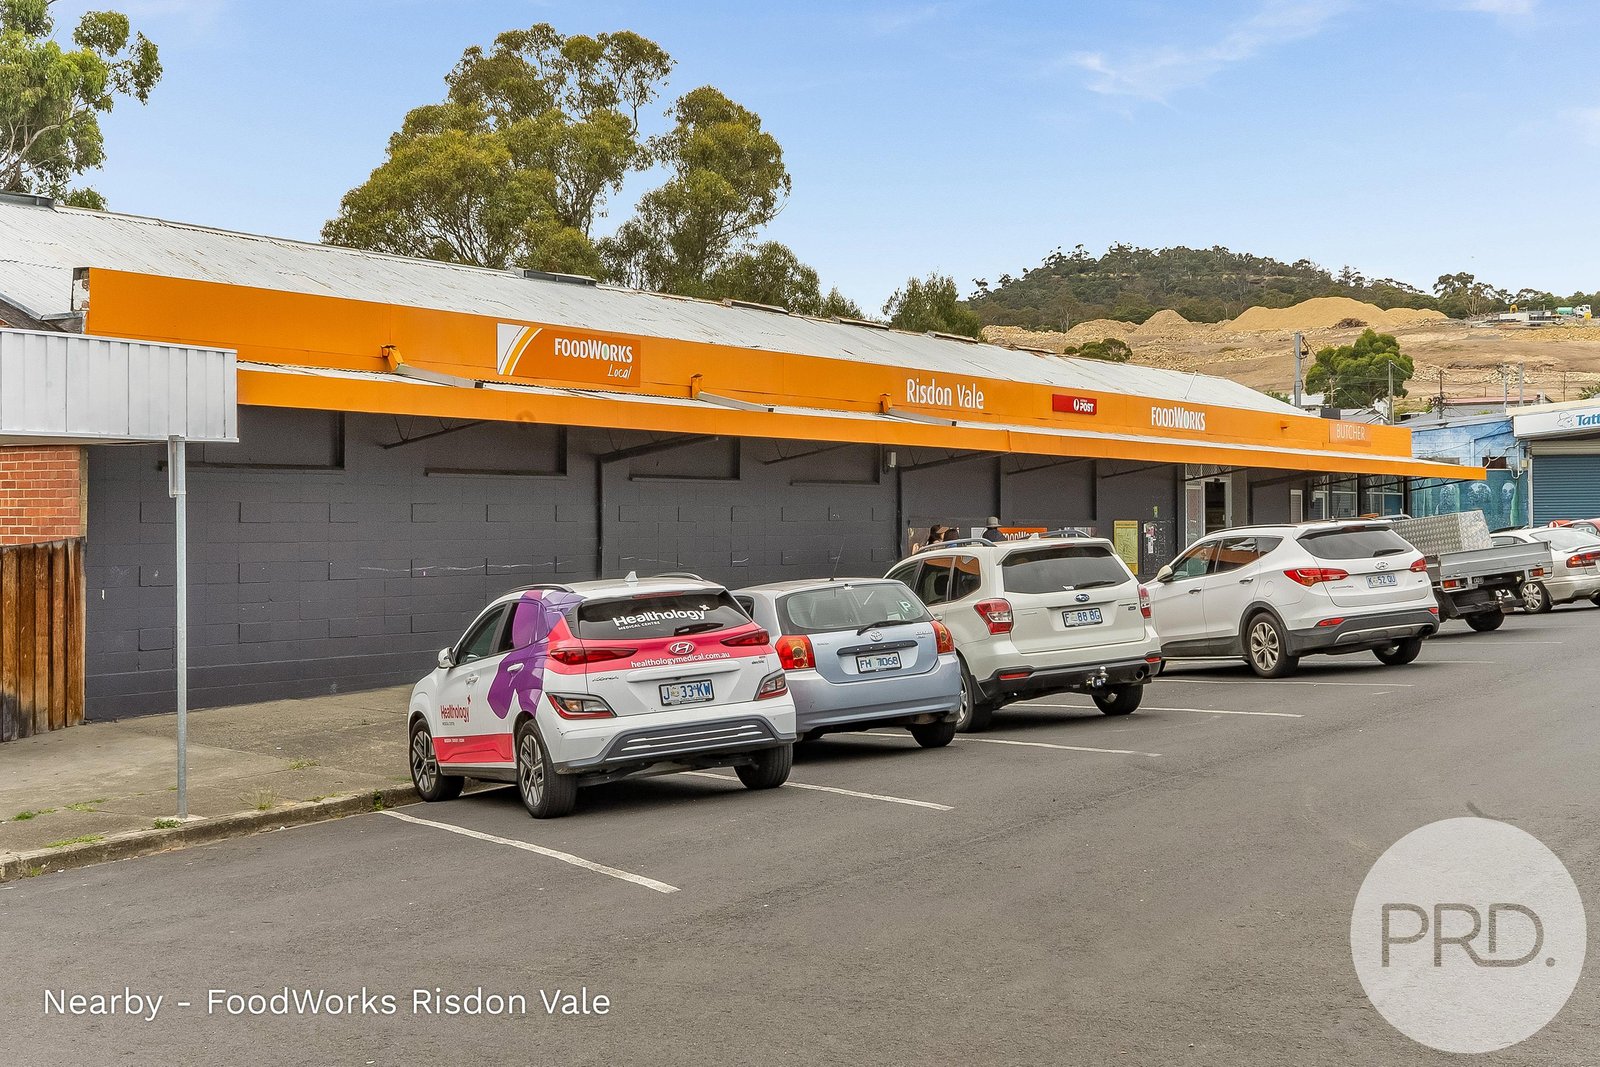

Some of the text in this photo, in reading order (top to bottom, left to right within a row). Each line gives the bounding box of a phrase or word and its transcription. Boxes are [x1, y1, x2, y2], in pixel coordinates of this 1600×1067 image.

[607, 363, 633, 380] Local
[906, 376, 985, 410] Risdon Vale
[1079, 402, 1094, 413] POST
[1336, 423, 1366, 440] BUTCHER
[612, 608, 706, 627] Healthology
[618, 620, 661, 631] MEDICAL CENTRE
[630, 652, 731, 668] healthologymedical.com.au
[860, 658, 872, 669] FH
